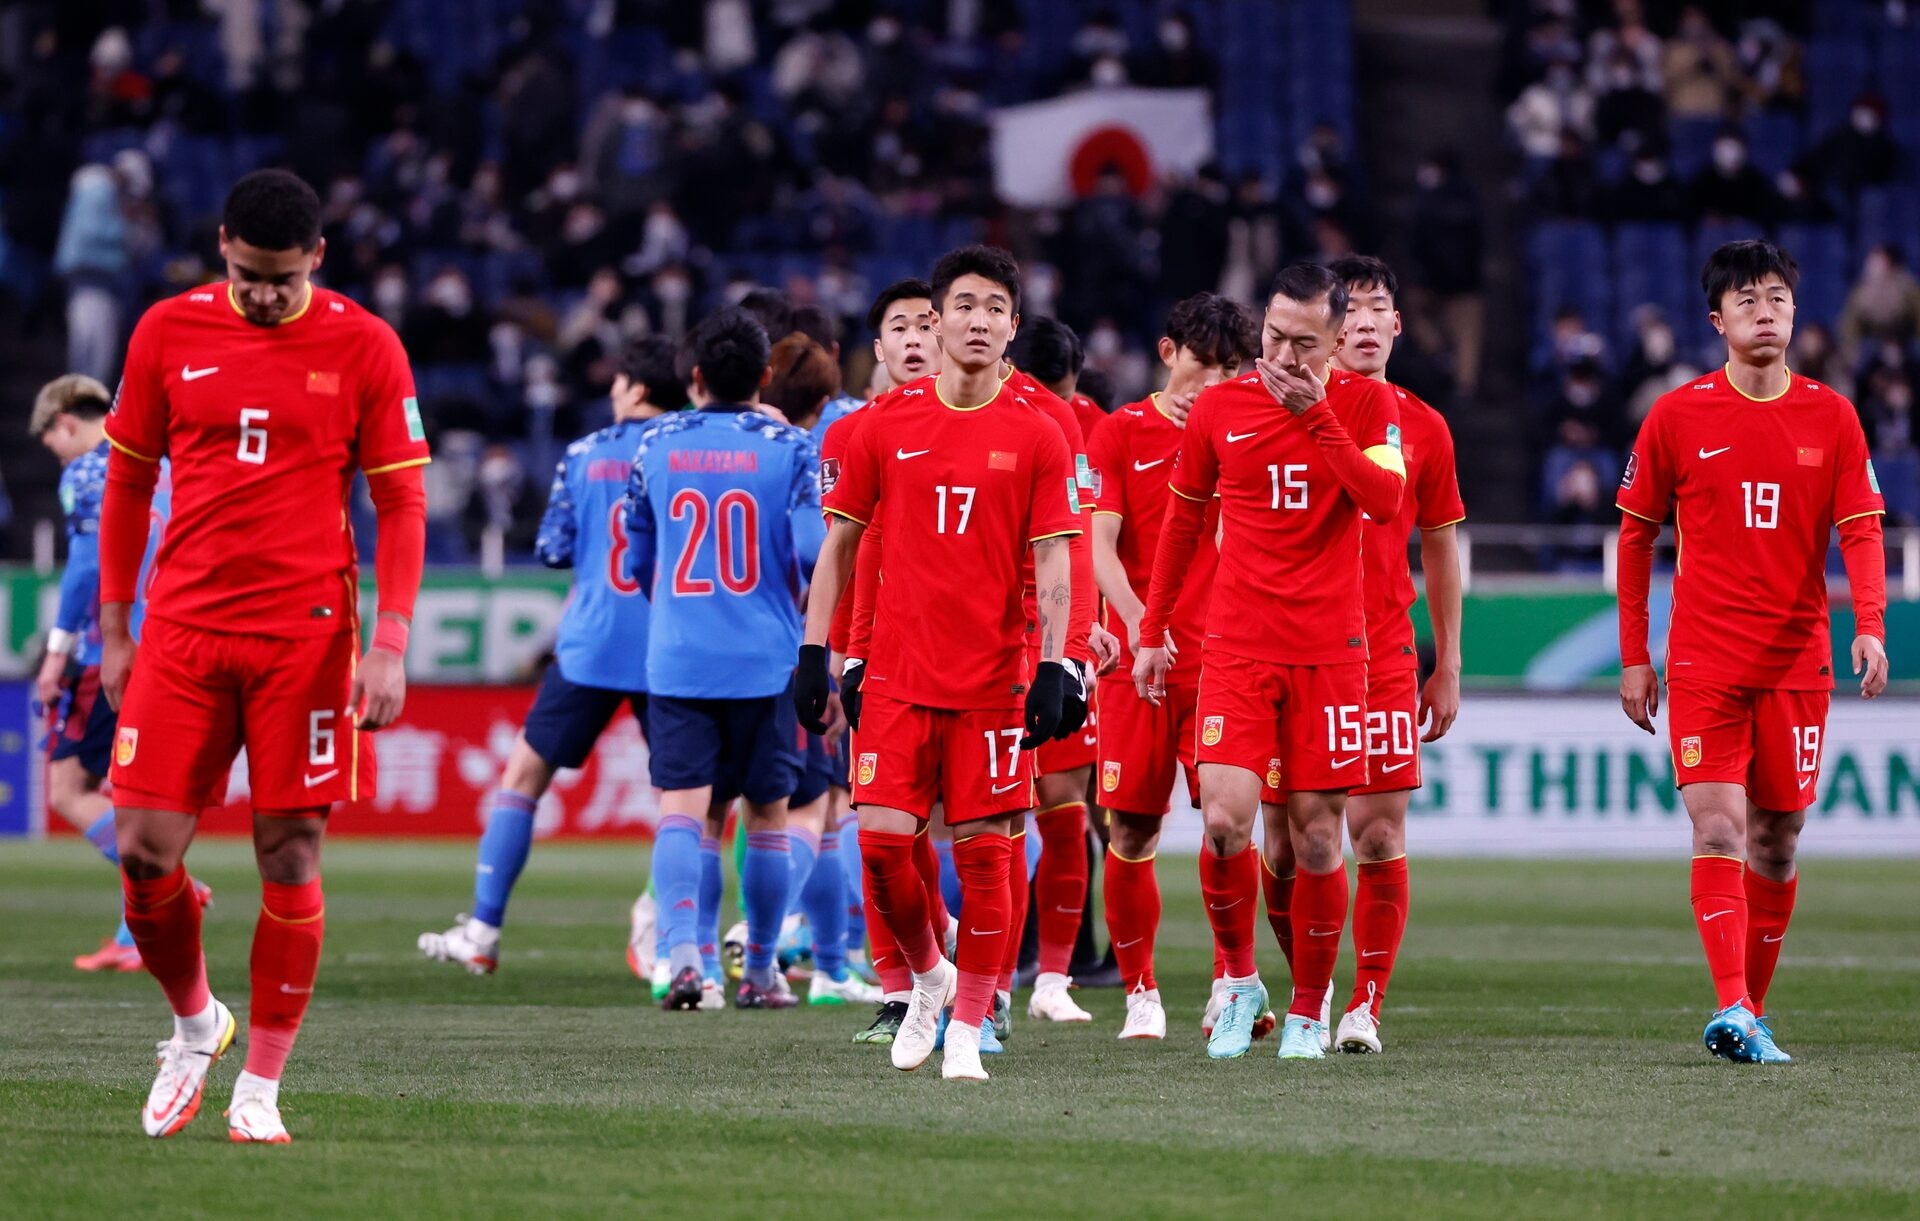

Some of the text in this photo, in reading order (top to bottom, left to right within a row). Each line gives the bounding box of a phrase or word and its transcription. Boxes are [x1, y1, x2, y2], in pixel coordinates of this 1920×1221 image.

[236, 407, 270, 465] 6
[668, 450, 757, 474] NAKAYAMA
[935, 485, 976, 535] 17
[1267, 464, 1309, 510] 15
[1741, 481, 1781, 530] 19
[669, 487, 761, 598] 20
[309, 709, 335, 765] 6
[984, 727, 1024, 778] 17
[1323, 704, 1362, 752] 15
[1366, 711, 1414, 756] 20
[1792, 725, 1820, 773] 19
